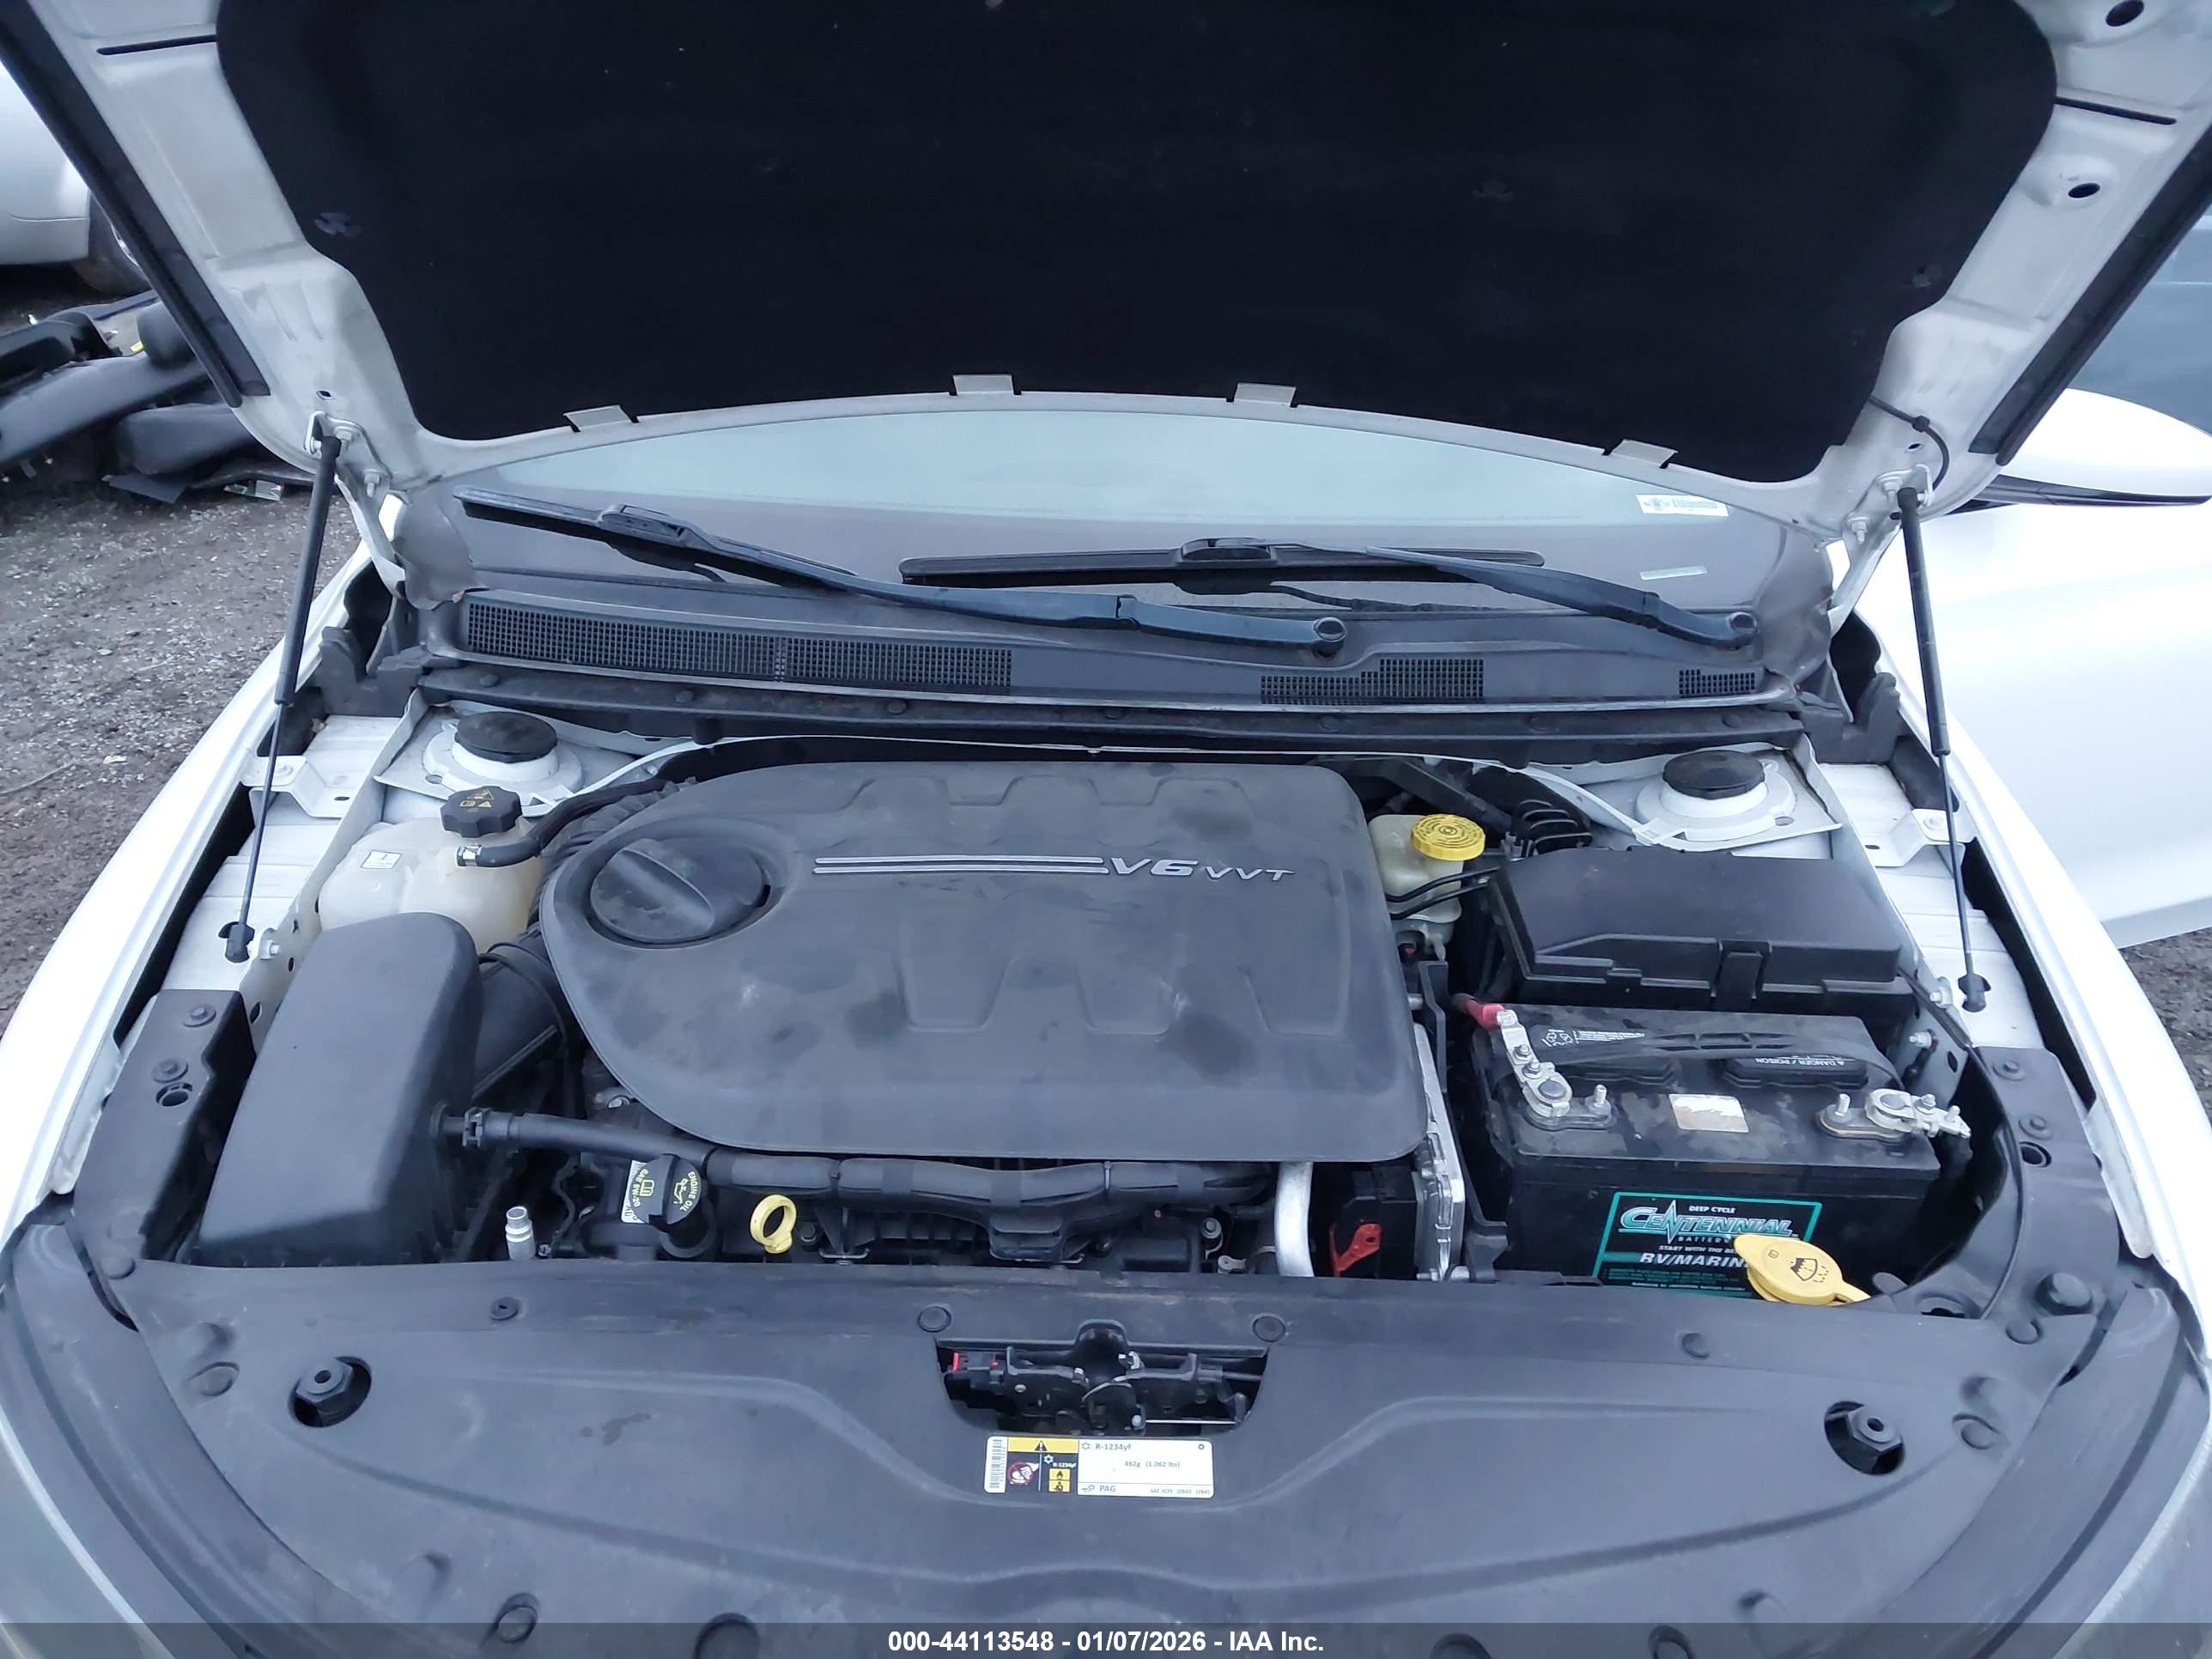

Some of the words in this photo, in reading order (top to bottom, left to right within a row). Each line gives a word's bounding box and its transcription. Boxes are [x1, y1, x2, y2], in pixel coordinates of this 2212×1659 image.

[1110, 857, 1199, 876] V6
[1205, 866, 1296, 881] VVT
[688, 1171, 699, 1200] ENGINE
[679, 1200, 693, 1212] OIL
[1711, 1206, 1736, 1214] CYCLE
[1640, 1252, 1747, 1268] RV/MARIN
[1095, 1443, 1132, 1452] R-1234yf
